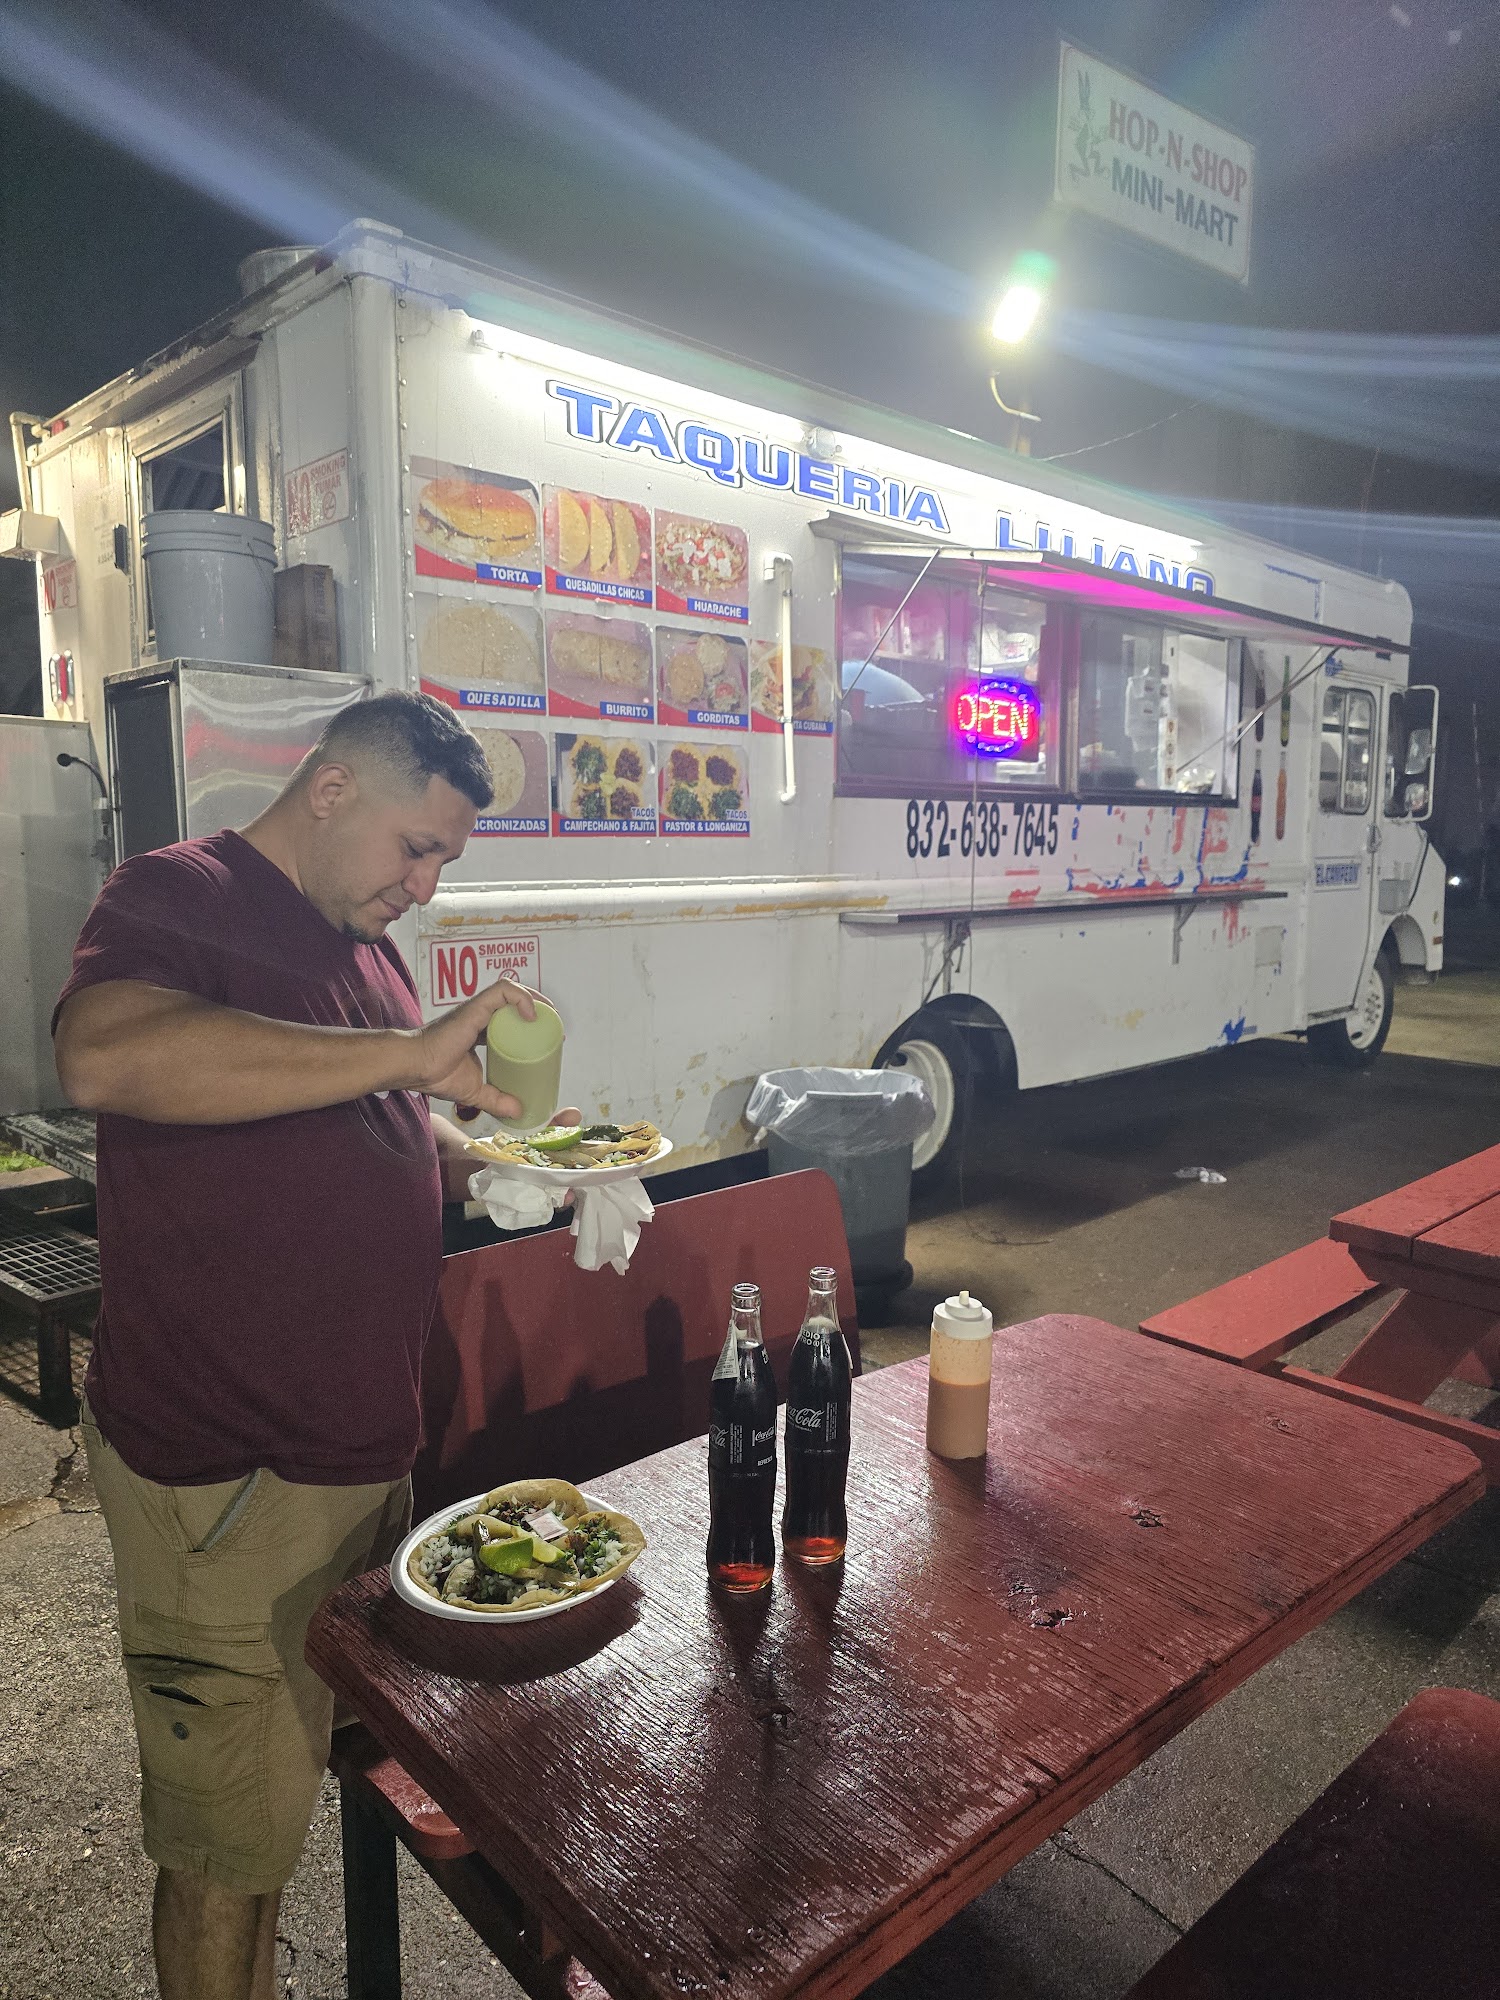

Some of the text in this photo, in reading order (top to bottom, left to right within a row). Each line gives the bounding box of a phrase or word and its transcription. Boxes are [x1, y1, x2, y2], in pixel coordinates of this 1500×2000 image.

[1111, 157, 1239, 246] MINI-MART
[546, 380, 950, 533] TAQUERIA
[310, 455, 346, 480] SMOKING
[491, 566, 529, 583] TORTA
[565, 578, 645, 601] QUESADILLAS CHICAS
[694, 600, 742, 618] HUARACHE
[467, 692, 541, 708] QUESADILLA
[606, 703, 649, 718] BURRITO
[697, 712, 740, 725] GORDITAS
[957, 693, 1030, 740] OPEN
[803, 721, 827, 732] CUBANA
[631, 807, 656, 818] TACOS
[727, 810, 748, 820] TACOS
[564, 821, 656, 832] CAMPECHANO & FAJITA
[665, 821, 748, 832] PASTOR & LONGANIZA
[906, 799, 1059, 859] 832-638-7645
[437, 941, 535, 999] NO SMOKING
[486, 956, 528, 970] FUMAR
[801, 1329, 821, 1341] EDIO
